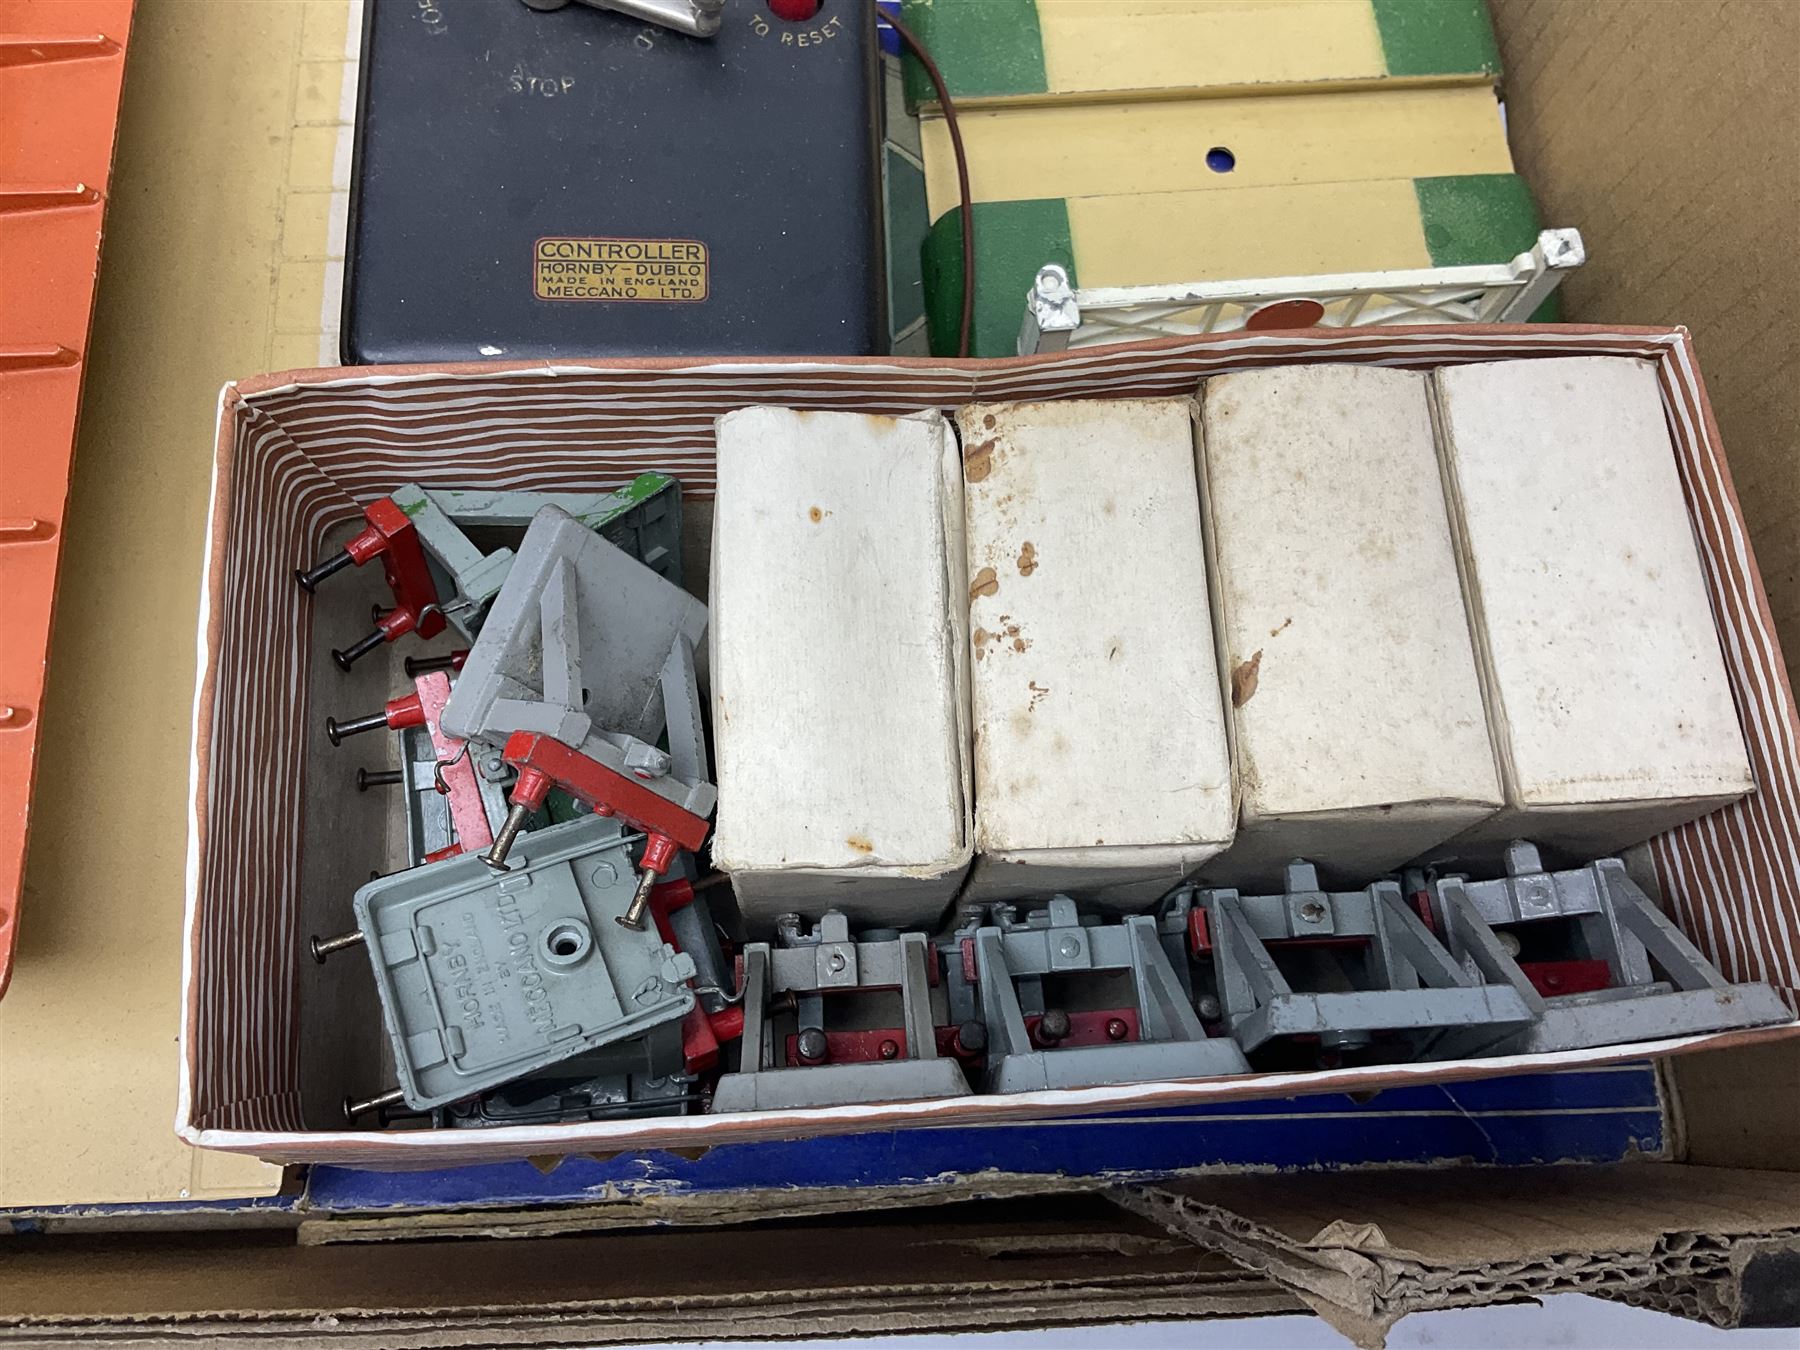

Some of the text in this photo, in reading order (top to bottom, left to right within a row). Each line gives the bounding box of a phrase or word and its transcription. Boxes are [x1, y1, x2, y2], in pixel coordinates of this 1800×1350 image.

[747, 13, 845, 47] TO RESET
[540, 242, 701, 261] CONTROLLER
[540, 262, 618, 275] HORNBY
[636, 264, 701, 277] DUBLO
[542, 277, 700, 287] MADE IN ENGLAND
[547, 286, 697, 299] MECCANO LTD.
[442, 941, 485, 1029] HORNBY
[508, 932, 558, 1035] MECCANO
